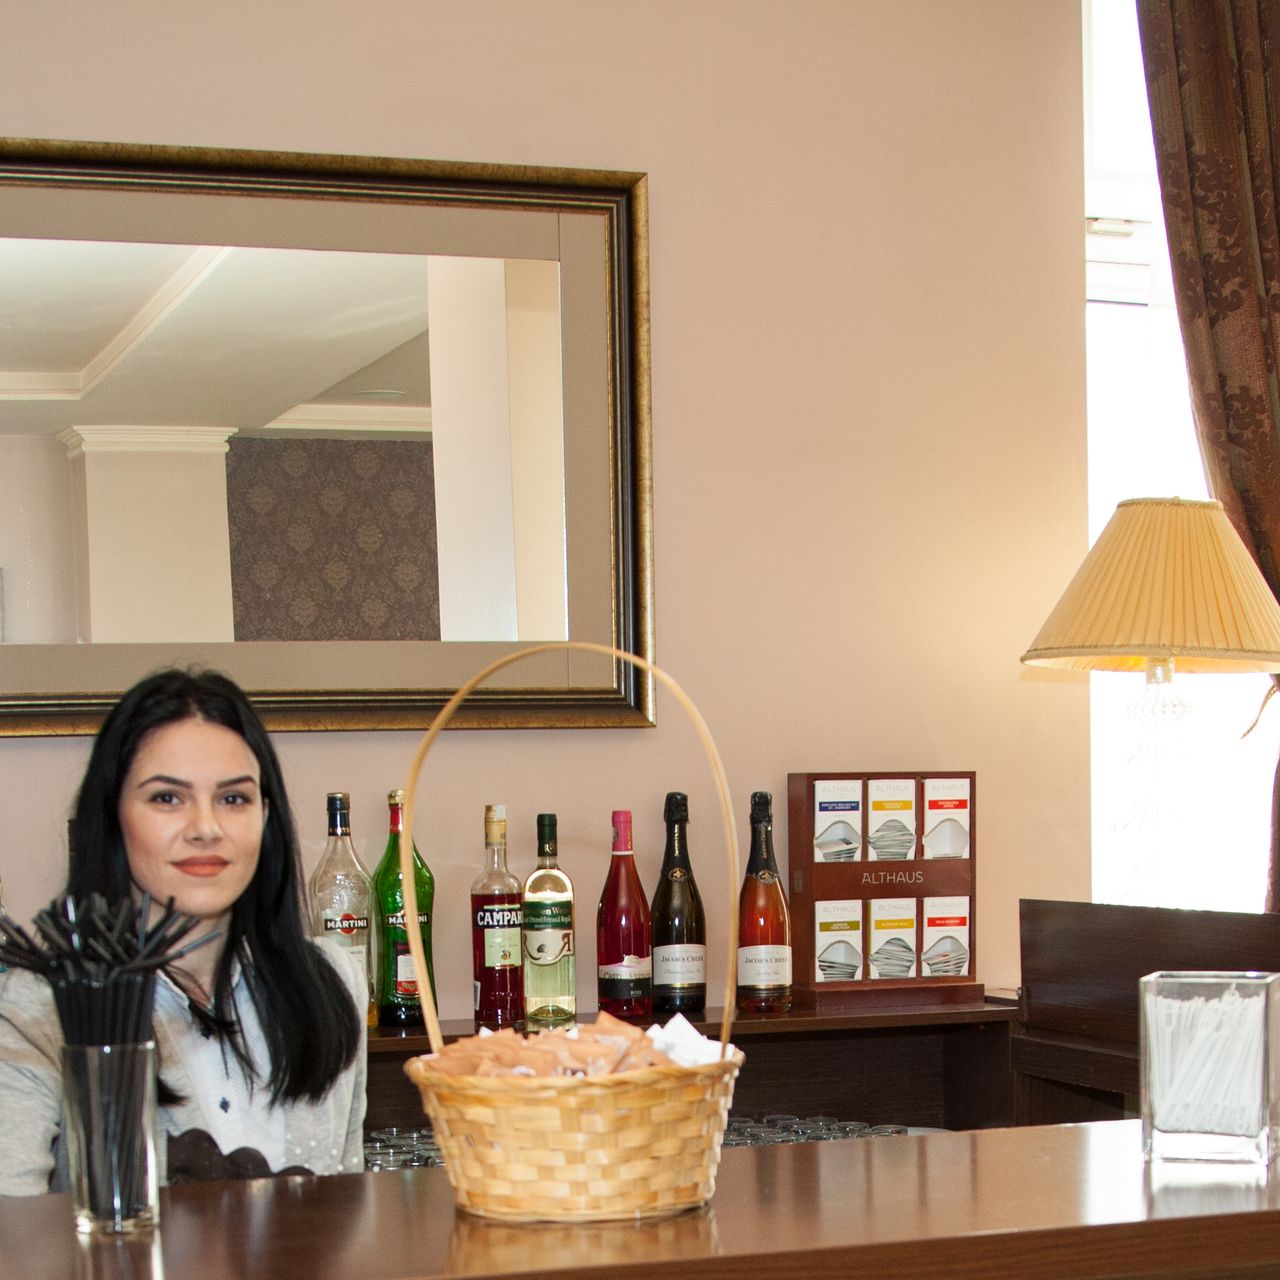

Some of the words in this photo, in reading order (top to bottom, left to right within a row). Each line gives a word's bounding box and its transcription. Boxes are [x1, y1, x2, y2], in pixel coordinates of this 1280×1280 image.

[862, 871, 924, 884] ALTHAUS
[327, 919, 367, 928] MARTINI
[388, 915, 428, 924] MANI
[477, 911, 523, 925] CAMPAR
